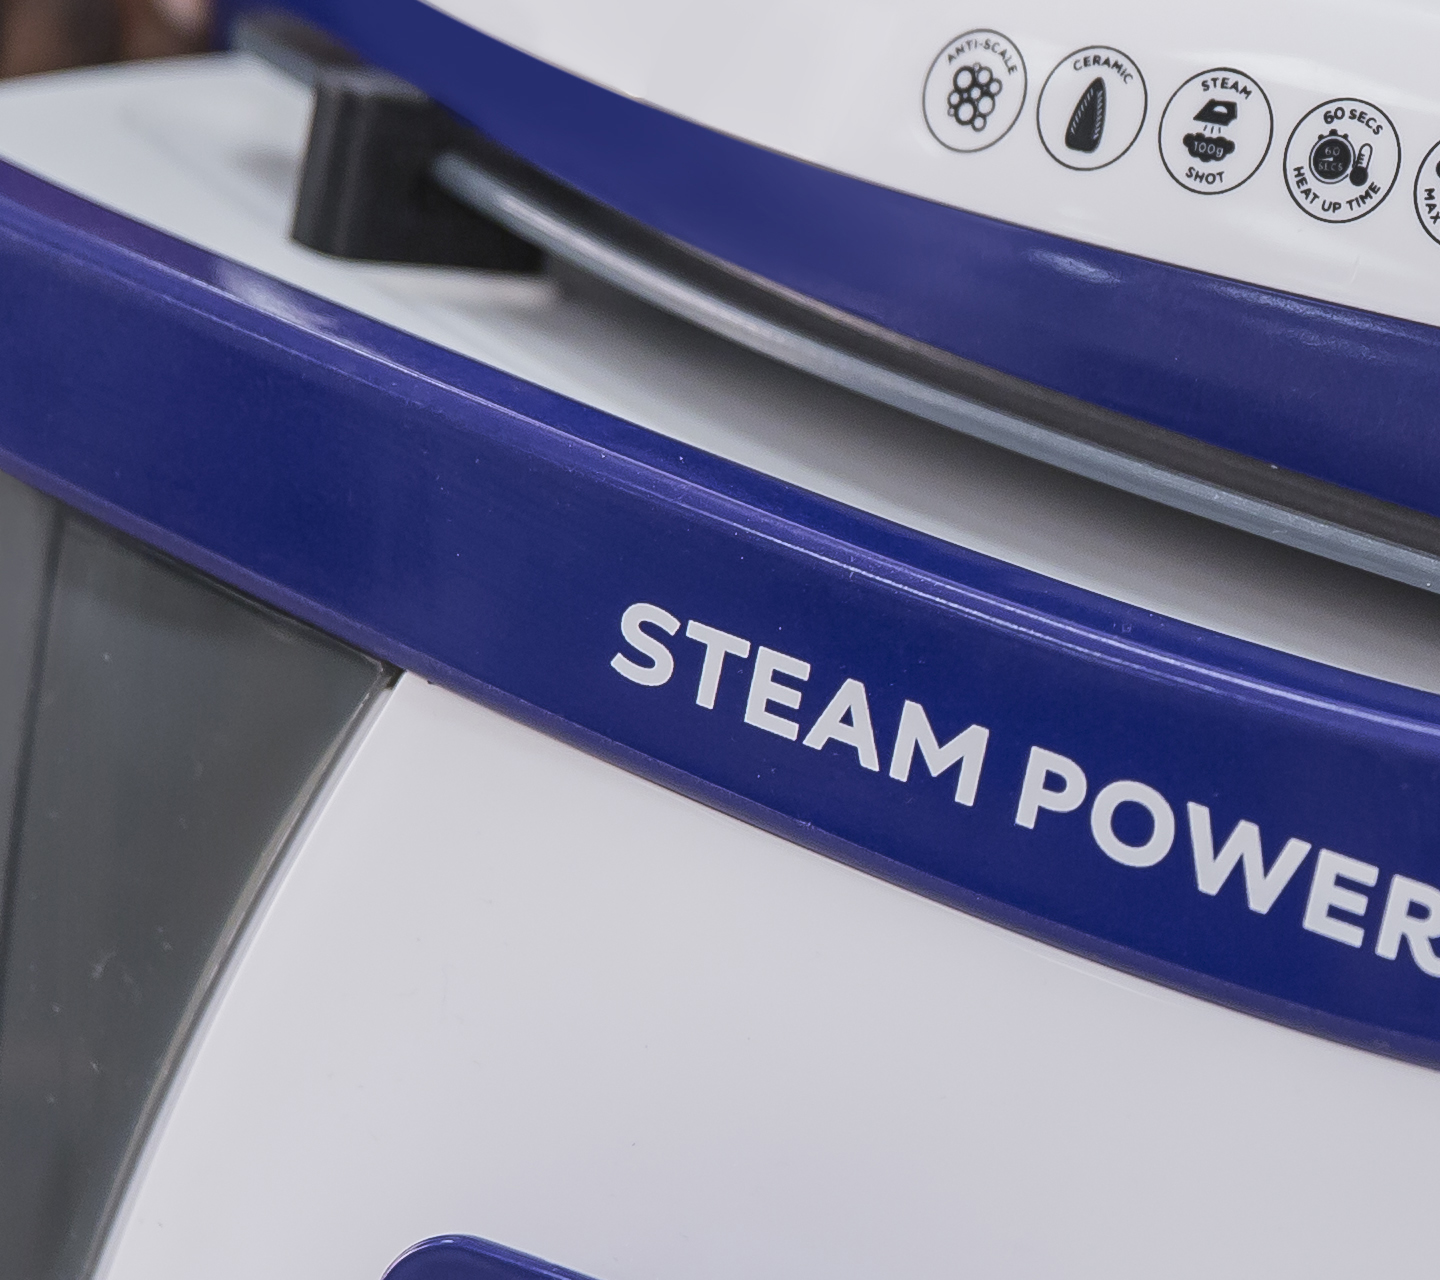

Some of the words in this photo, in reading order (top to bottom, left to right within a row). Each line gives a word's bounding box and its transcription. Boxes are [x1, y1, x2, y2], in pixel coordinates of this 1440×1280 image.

[947, 38, 1018, 75] ANTI-SCALE
[1073, 55, 1134, 84] CERAMIC
[1201, 77, 1252, 100] STEAM
[1323, 106, 1346, 125] 60
[1348, 108, 1384, 135] SECS
[1194, 141, 1224, 158] 100g
[1324, 146, 1340, 156] 60
[1185, 166, 1225, 185] SHOT
[1293, 166, 1320, 205] HEAT
[1321, 199, 1342, 213] UP
[1346, 181, 1381, 211] TIME
[609, 601, 991, 807] STEAM
